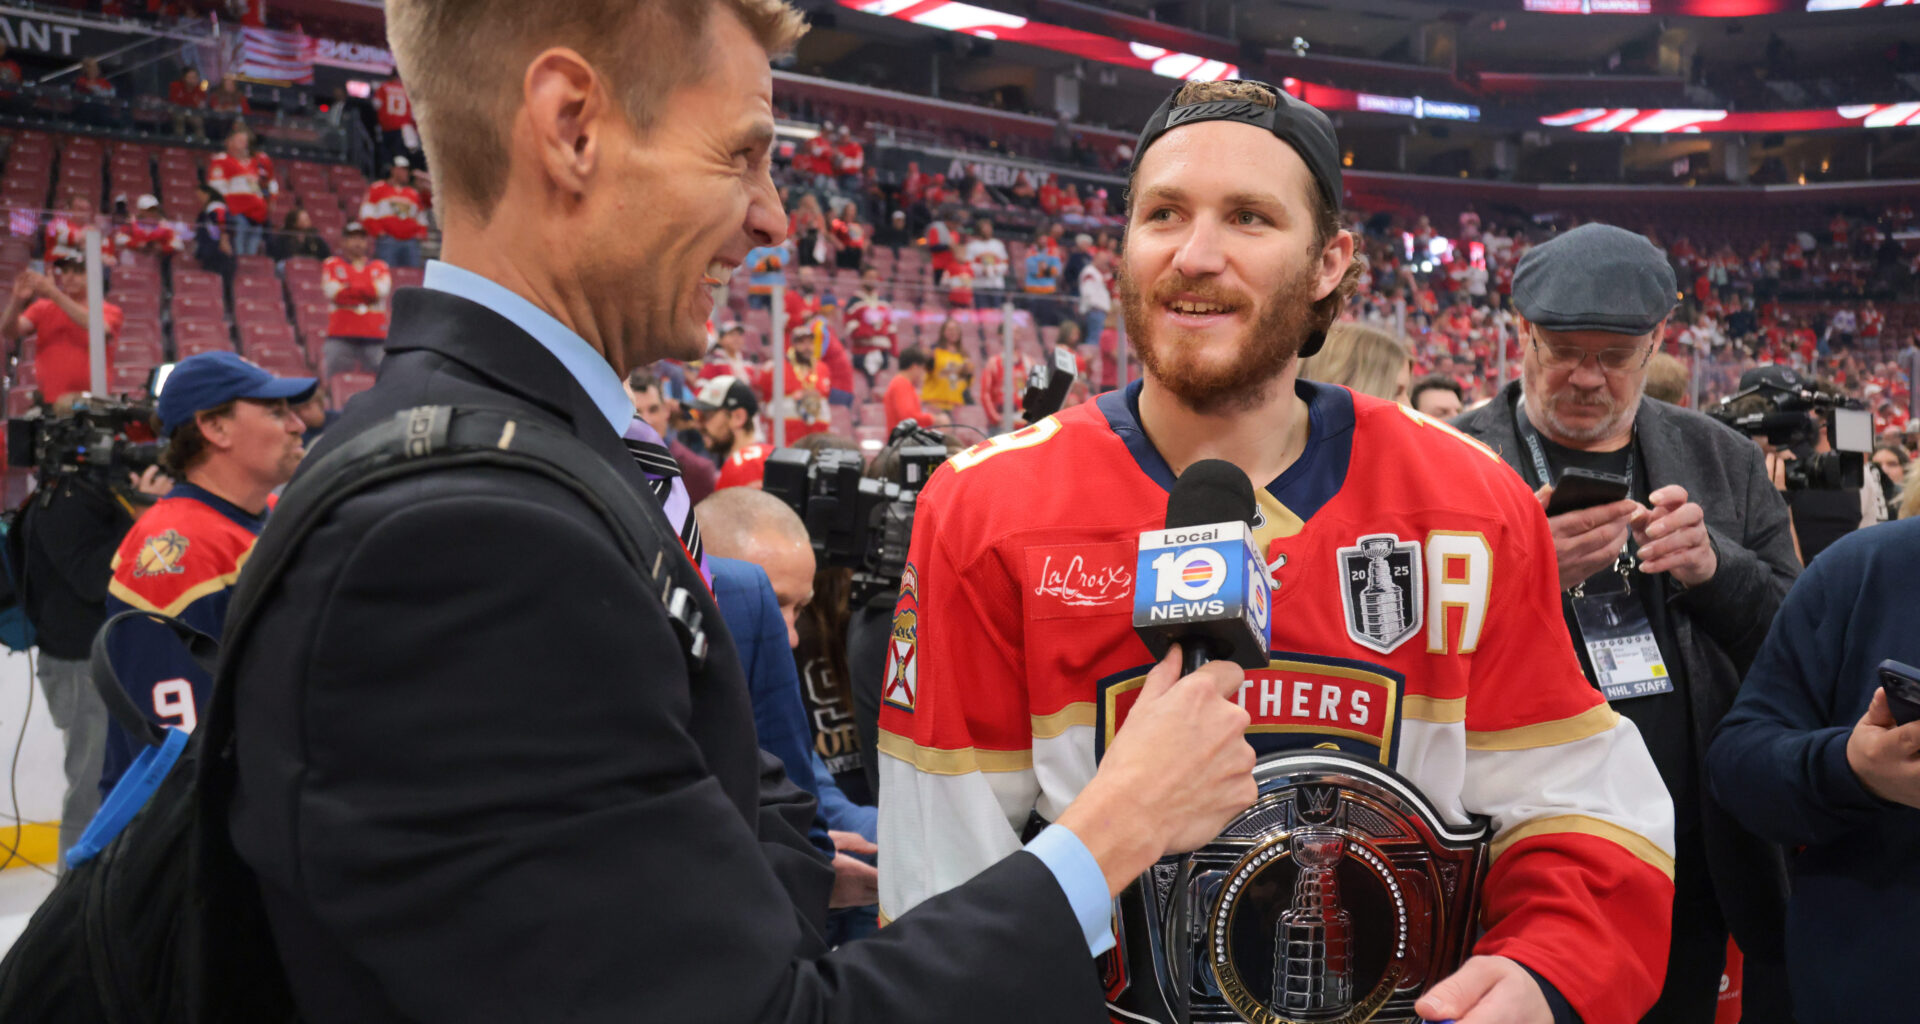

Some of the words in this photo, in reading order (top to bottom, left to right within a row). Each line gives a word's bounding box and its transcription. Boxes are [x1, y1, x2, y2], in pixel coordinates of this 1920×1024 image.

[1163, 528, 1219, 545] Local
[1034, 554, 1133, 606] LaCroix
[1152, 547, 1228, 602] 10
[1247, 557, 1268, 631] 10
[1351, 570, 1366, 581] 20
[1393, 565, 1410, 577] 25
[1425, 529, 1494, 655] A
[1151, 600, 1225, 621] NEWS
[152, 677, 198, 735] 9
[1606, 685, 1631, 698] NHL
[1633, 680, 1668, 694] STAFF
